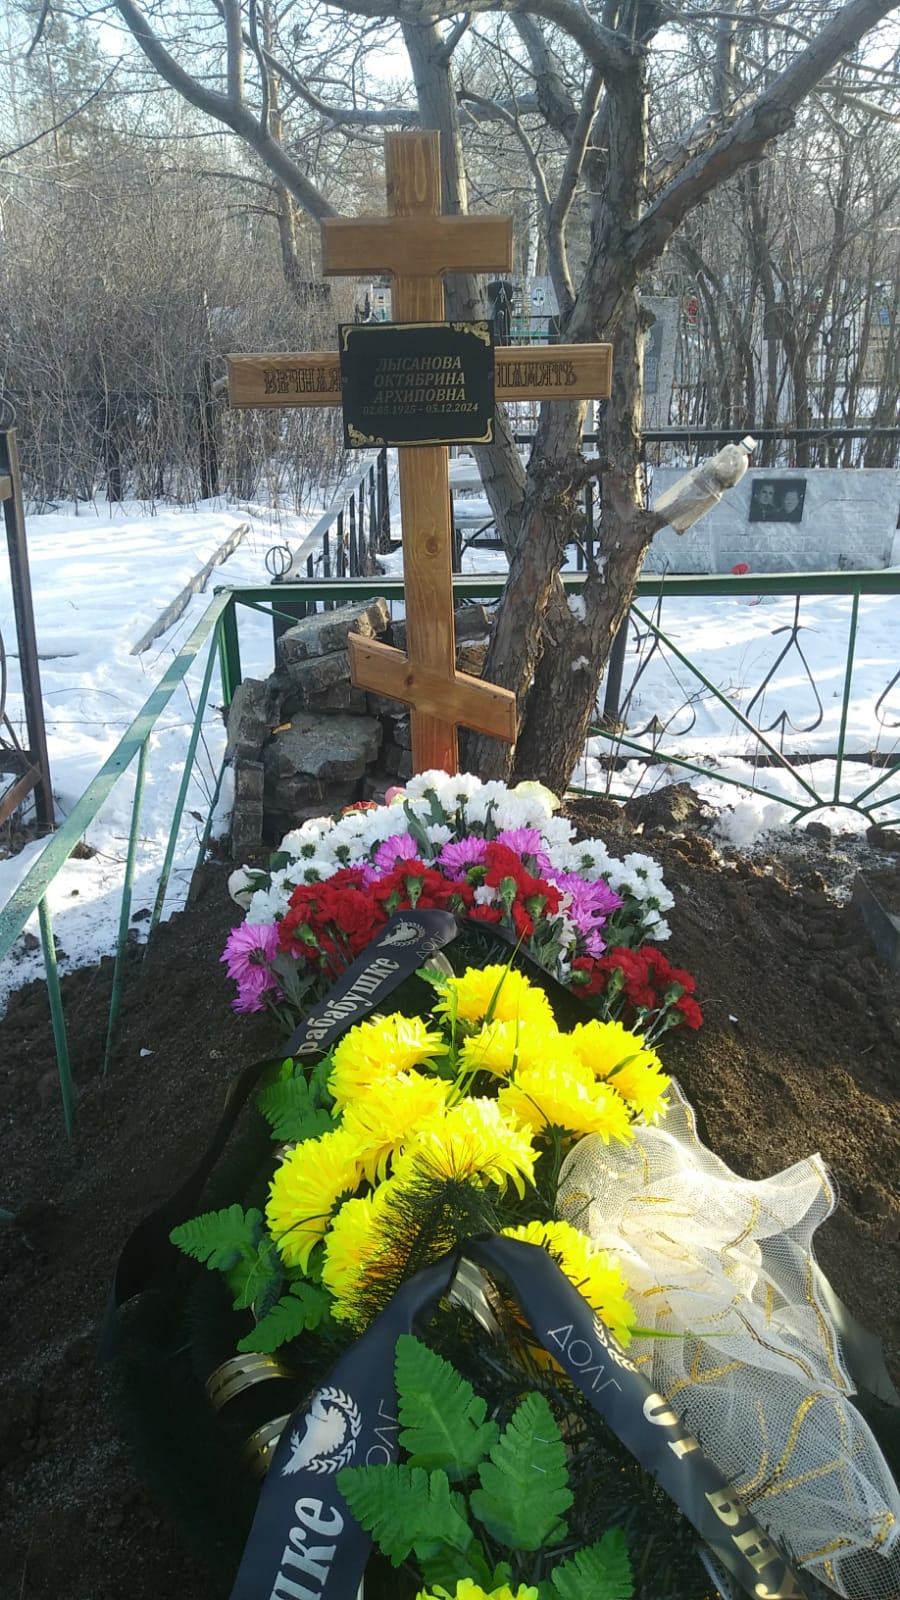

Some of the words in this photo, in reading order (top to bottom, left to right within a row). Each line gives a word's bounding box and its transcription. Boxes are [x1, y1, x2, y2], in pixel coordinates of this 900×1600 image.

[376, 356, 461, 372] ЛЫСАНОВА
[374, 372, 466, 388] ОКТЯБРИНА
[496, 361, 577, 388] ПАМЯТЬ
[373, 388, 466, 403] АРХИПОВНА
